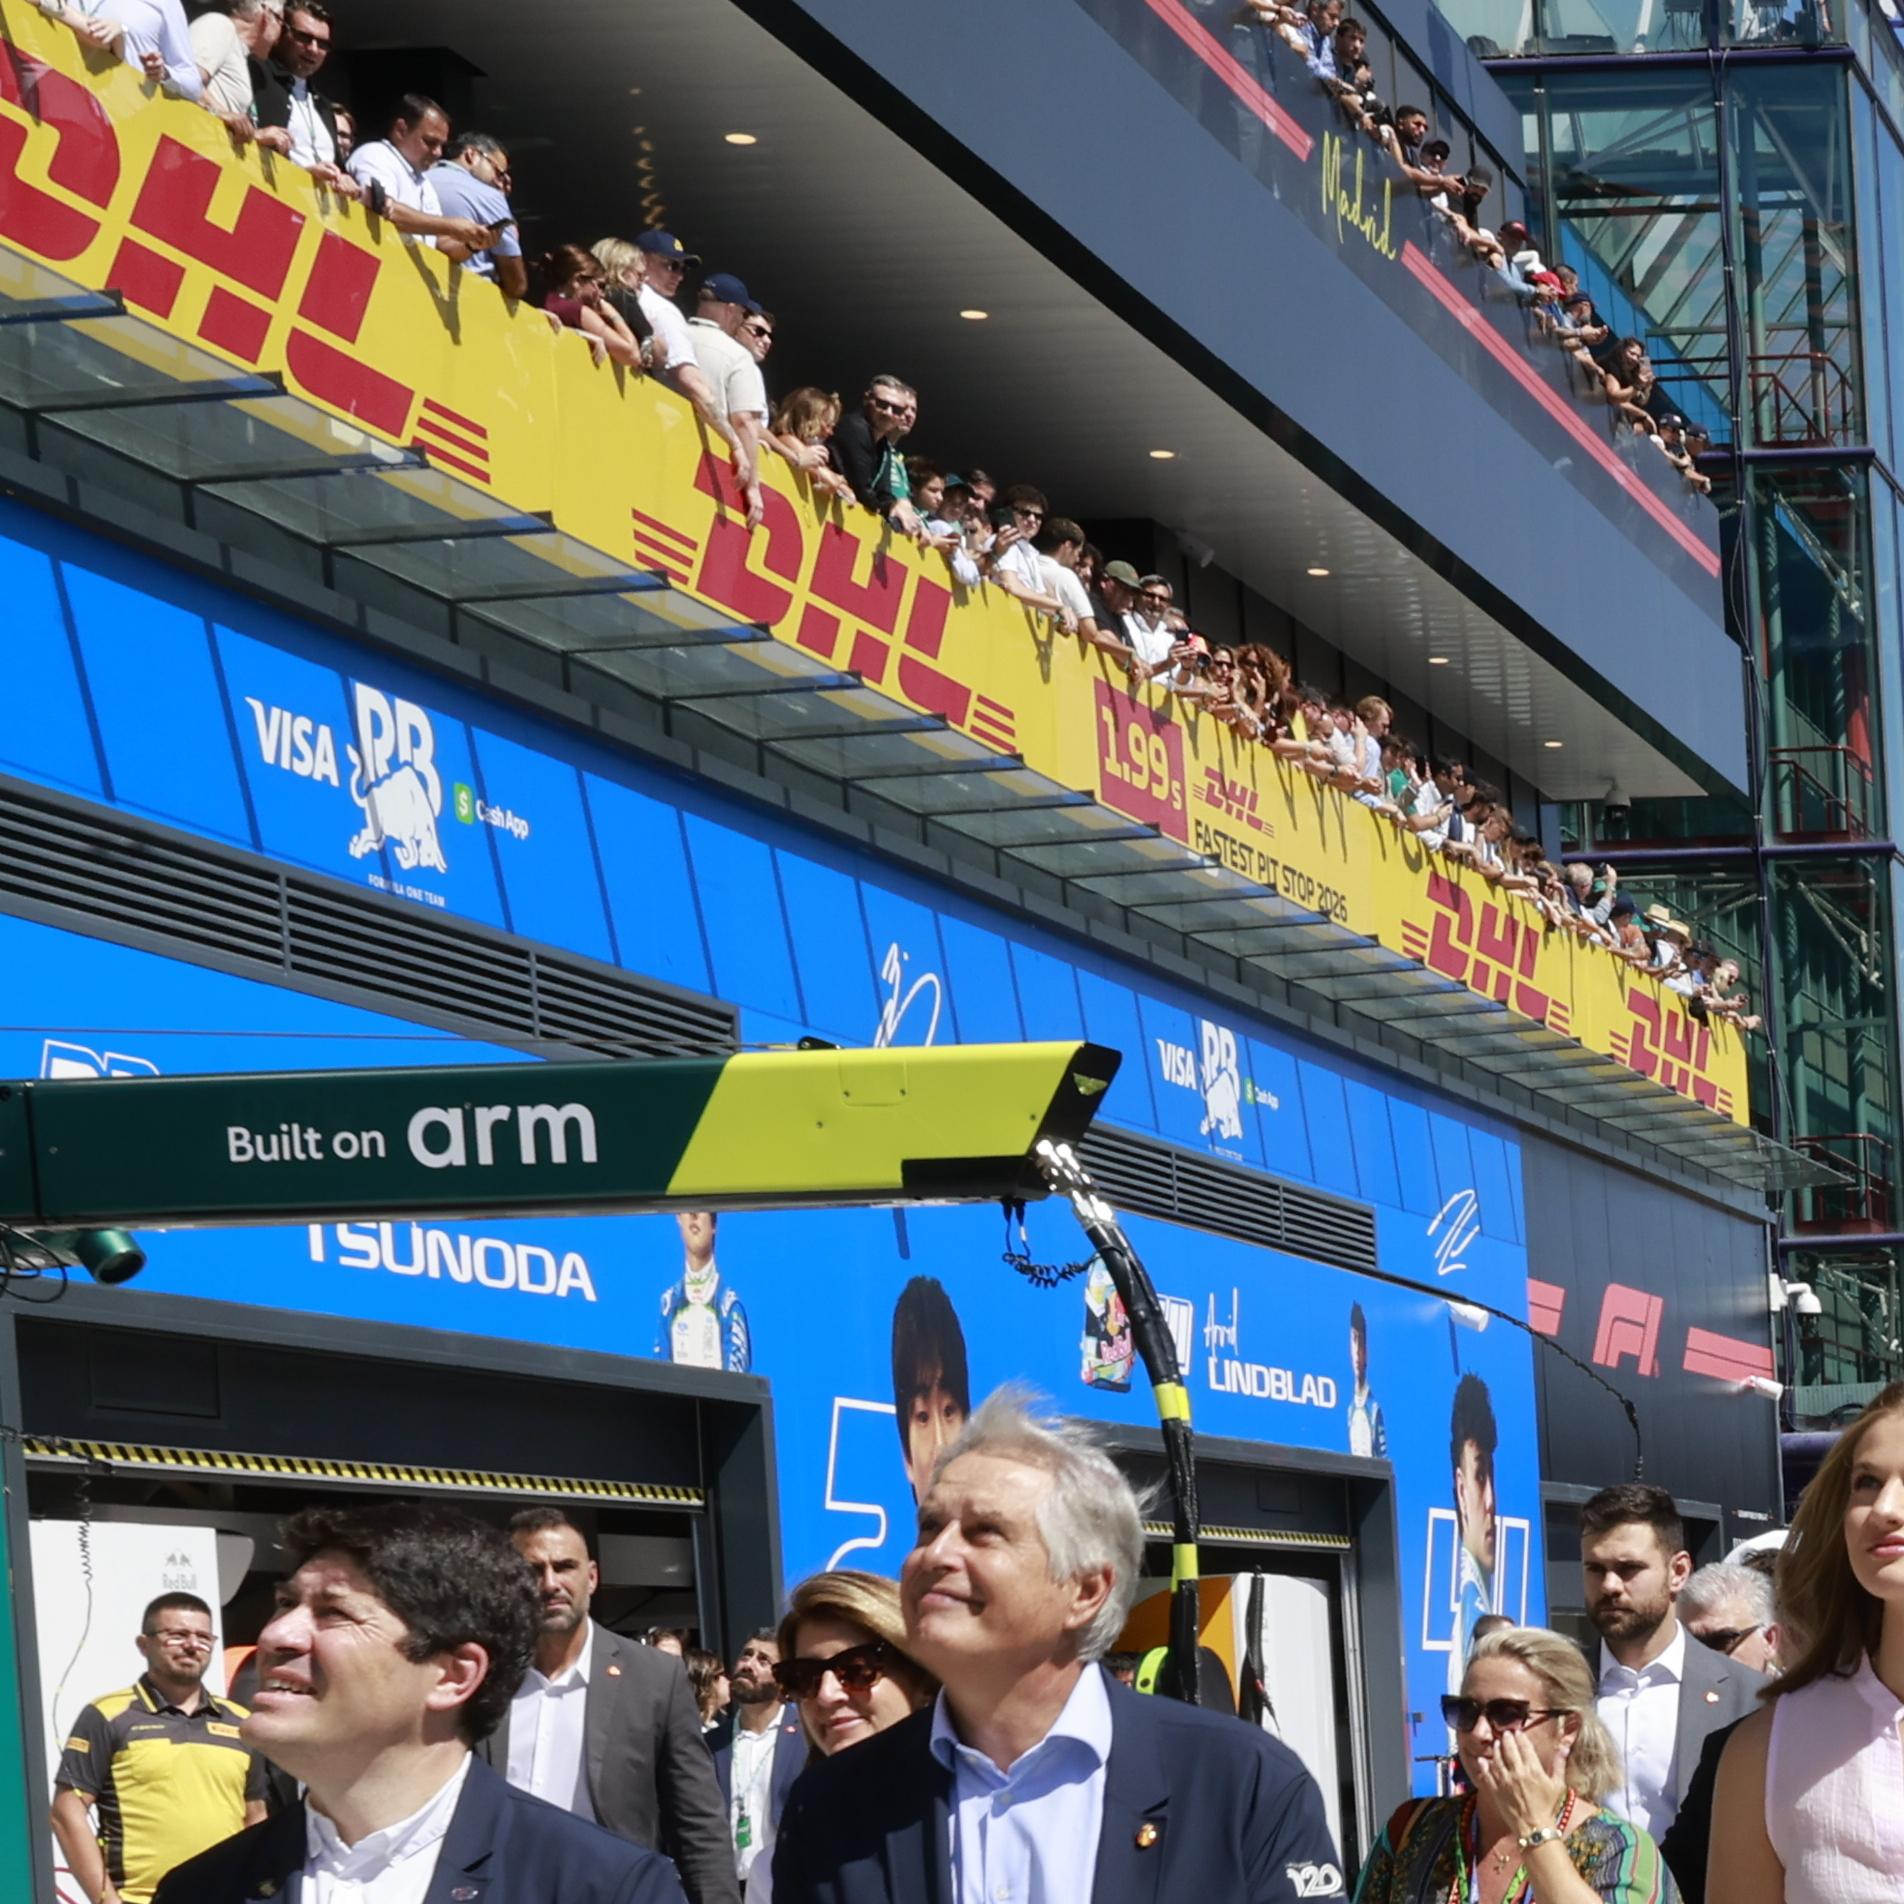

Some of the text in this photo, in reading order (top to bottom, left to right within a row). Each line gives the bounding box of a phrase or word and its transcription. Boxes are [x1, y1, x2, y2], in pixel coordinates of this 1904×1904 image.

[0, 38, 414, 439] DHL
[1321, 130, 1397, 260] Madrid
[694, 450, 971, 727] DHL
[245, 696, 340, 787] VISA
[475, 799, 506, 829] Cash
[506, 811, 530, 840] App
[1204, 765, 1265, 831] DHL
[1194, 819, 1348, 923] FASTEST PIT STOP 2026
[1427, 871, 1549, 1029] DHL
[1156, 1038, 1197, 1091] VISA
[1627, 986, 1717, 1110] DHL
[227, 1102, 599, 1169] Built on arm
[1208, 1356, 1337, 1409] LINDBLAD
